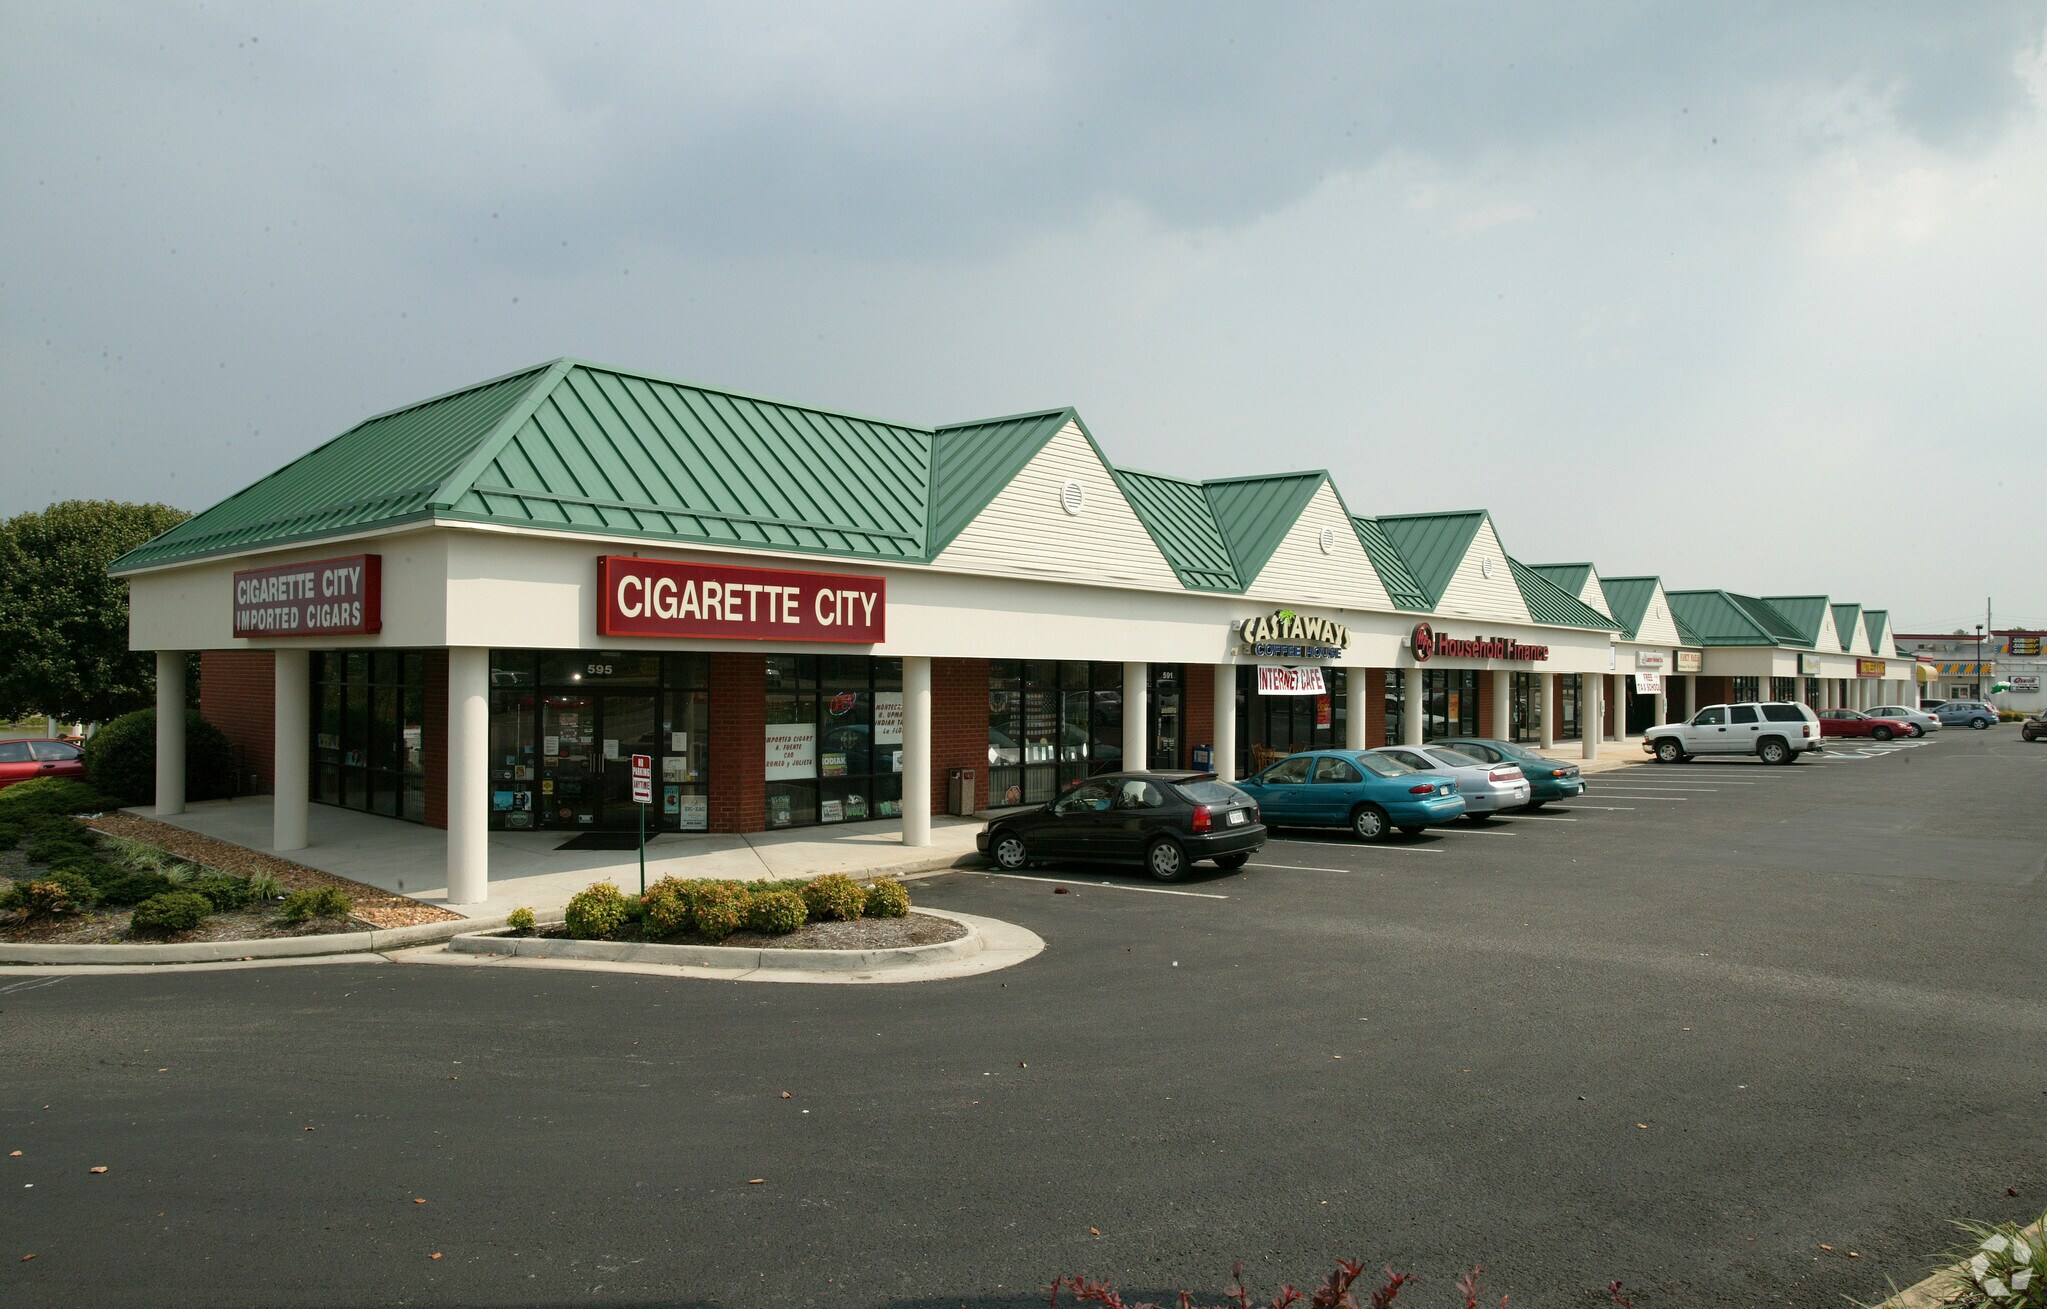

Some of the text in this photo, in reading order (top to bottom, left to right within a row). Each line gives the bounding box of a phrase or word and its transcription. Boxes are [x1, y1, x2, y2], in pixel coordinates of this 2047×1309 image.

[237, 566, 361, 605] CIGARETTE CITY
[617, 575, 878, 627] CIGARETTE CITY
[237, 601, 361, 631] IMPORTED CIGARS
[1242, 611, 1352, 649] CASTAWAYS
[1256, 642, 1341, 659] COFFEE HOUSE
[1438, 634, 1549, 661] Household Finance
[587, 664, 613, 675] 595
[1162, 671, 1173, 679] 591
[1259, 667, 1323, 691] INTERNET CAFE
[830, 693, 854, 712] OPEN
[633, 767, 651, 776] PARKING
[633, 781, 650, 790] ANYTIME
